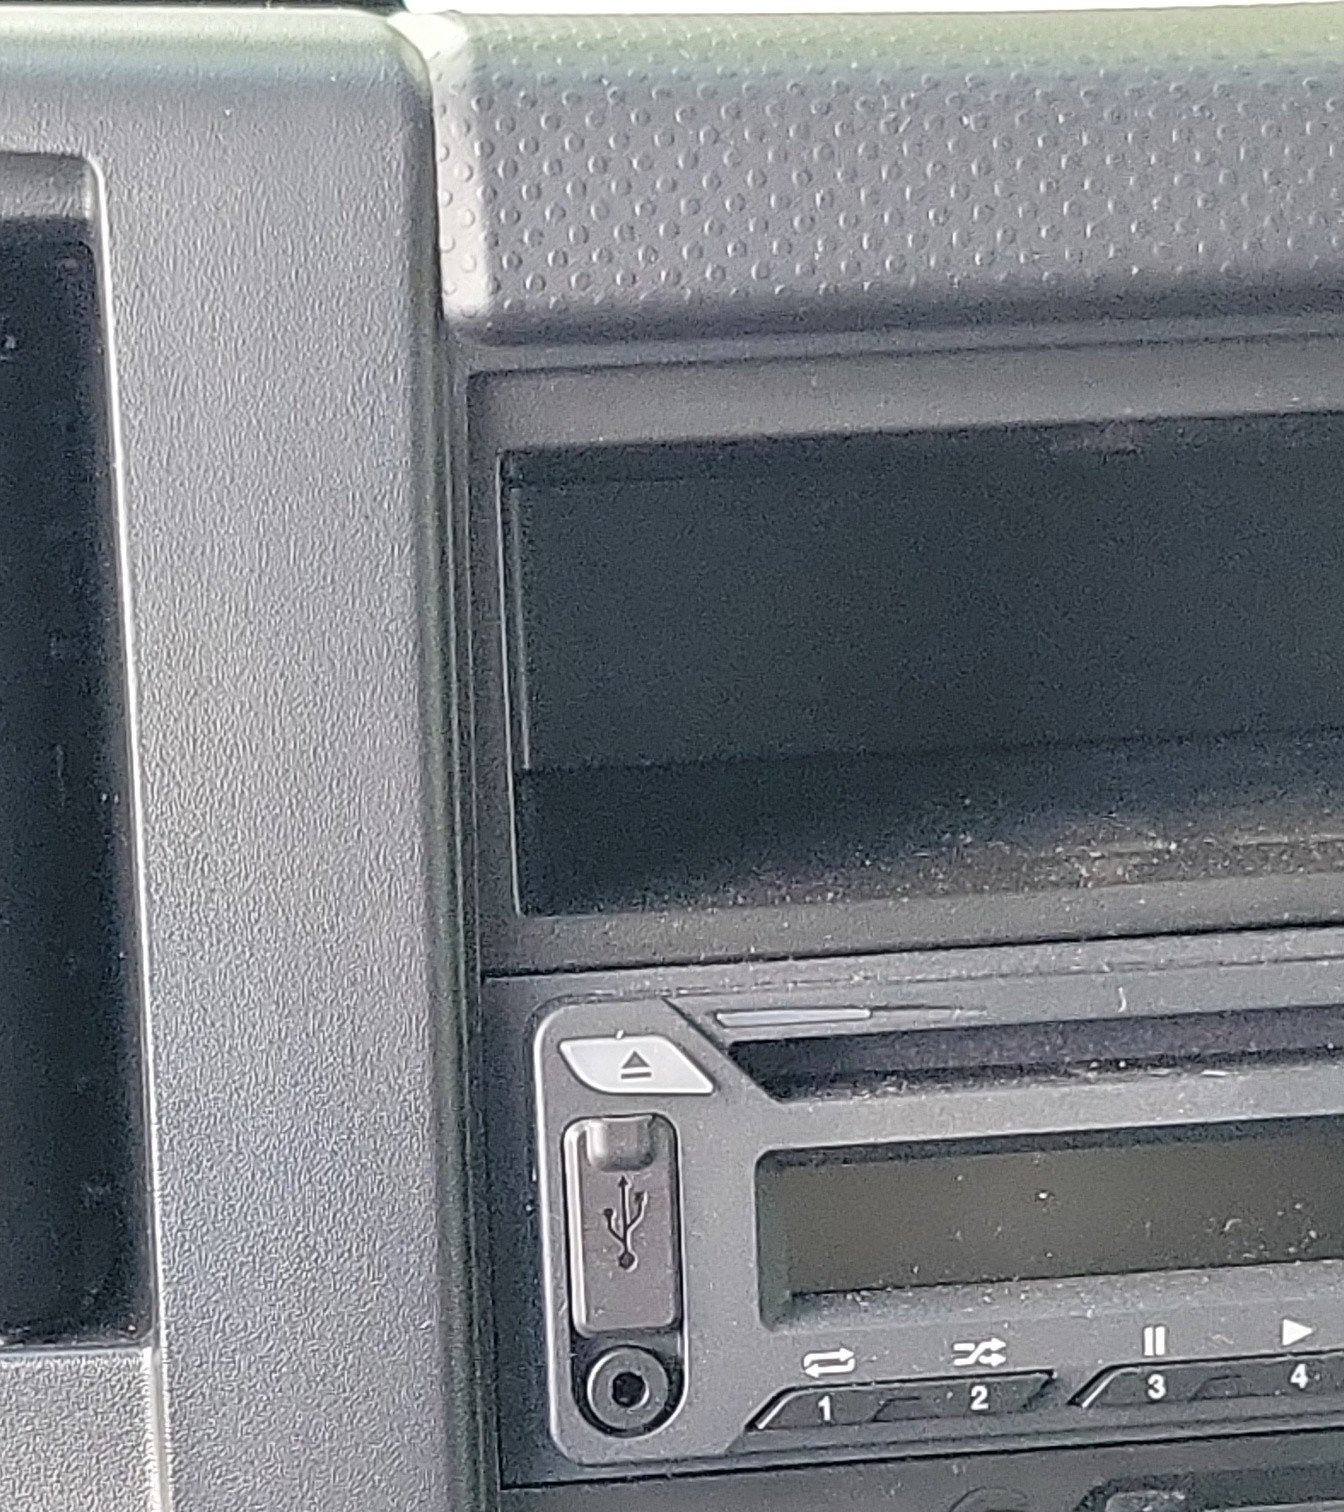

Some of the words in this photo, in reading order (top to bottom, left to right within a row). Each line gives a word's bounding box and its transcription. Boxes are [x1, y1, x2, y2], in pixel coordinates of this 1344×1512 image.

[1147, 1373, 1166, 1399] 3
[1289, 1364, 1308, 1389] 4
[819, 1396, 834, 1420] 1
[971, 1385, 989, 1410] 2
